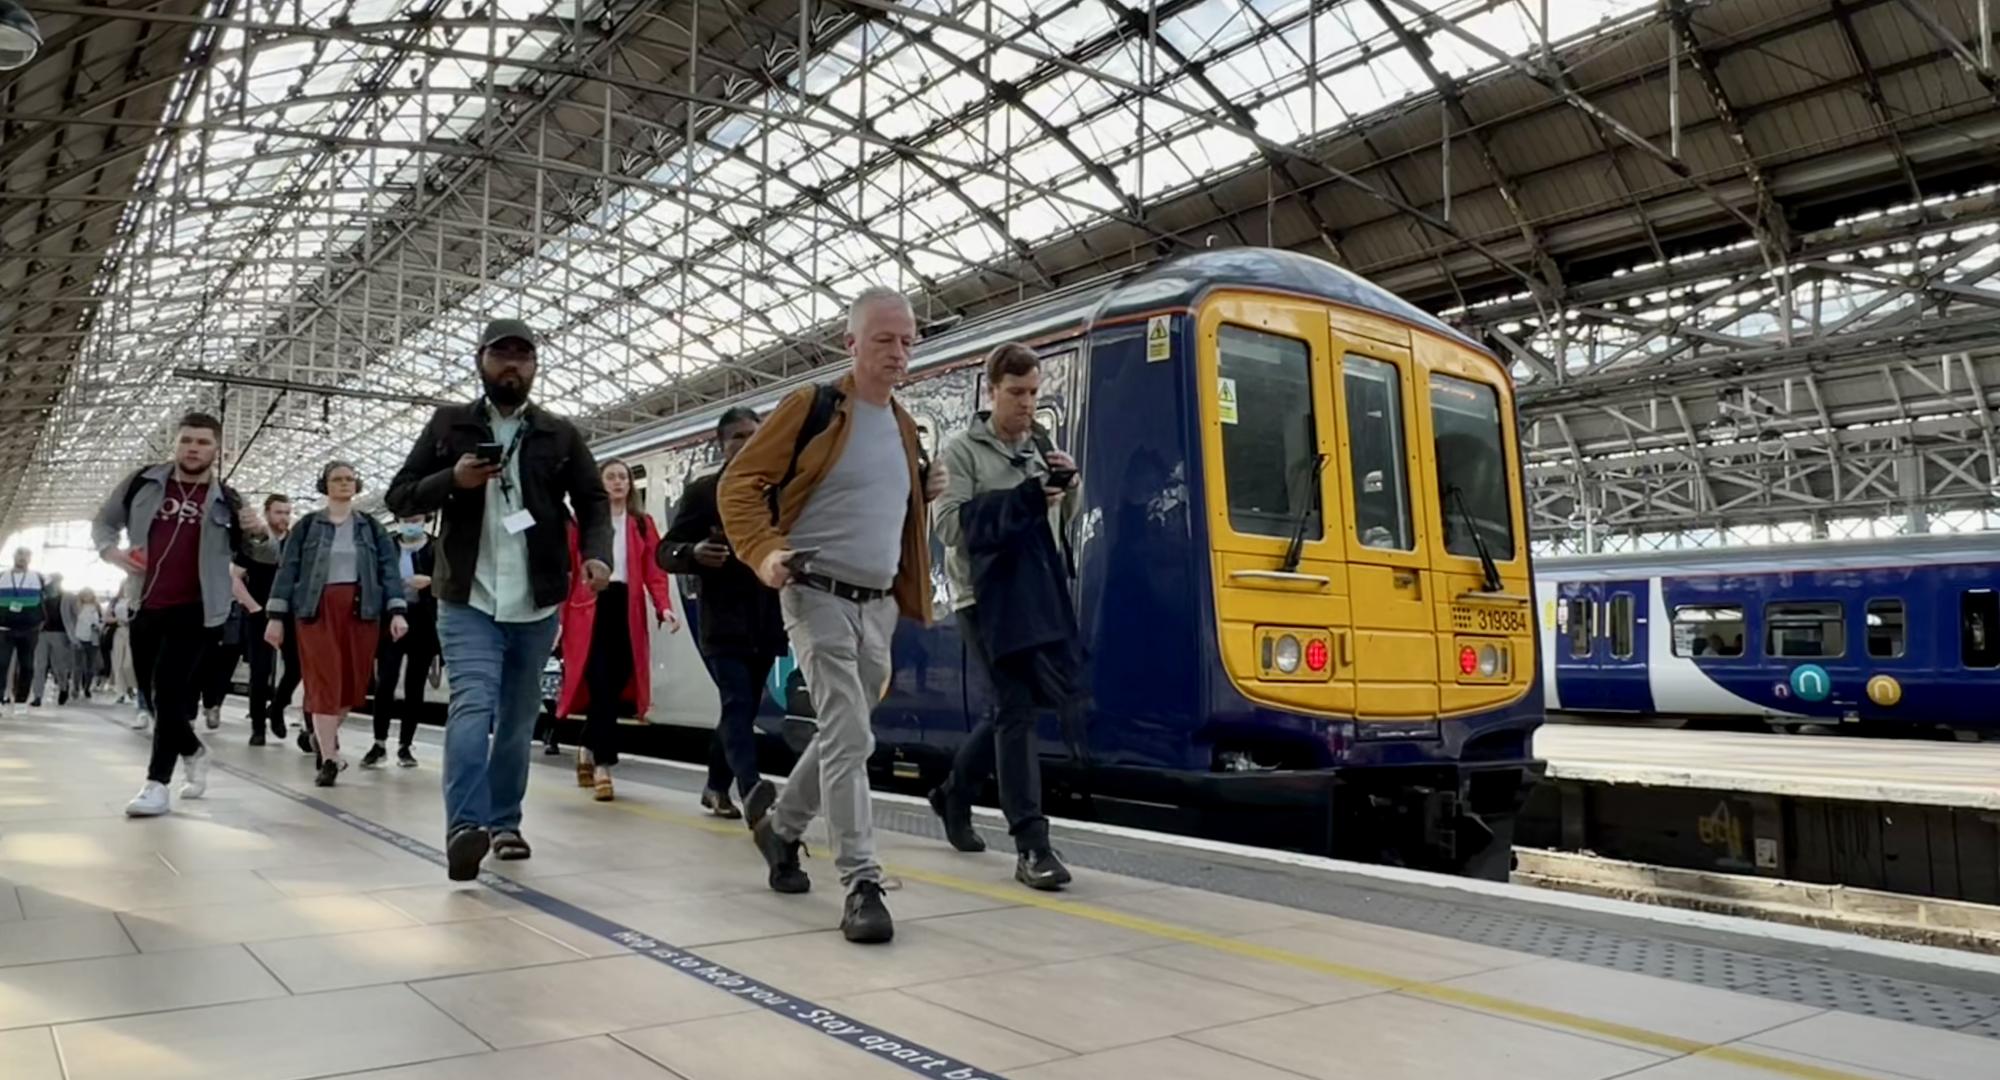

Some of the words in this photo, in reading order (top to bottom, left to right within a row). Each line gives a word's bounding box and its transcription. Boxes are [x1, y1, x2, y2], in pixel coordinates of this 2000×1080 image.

[156, 497, 204, 518] OS
[1478, 608, 1527, 631] 319384
[1799, 670, 1822, 693] n
[611, 931, 657, 949] Help
[651, 949, 679, 958] us
[671, 956, 701, 968] to
[693, 966, 745, 986] help
[730, 986, 788, 1005] you
[797, 1009, 864, 1035] Stay
[859, 1034, 948, 1070] apart
